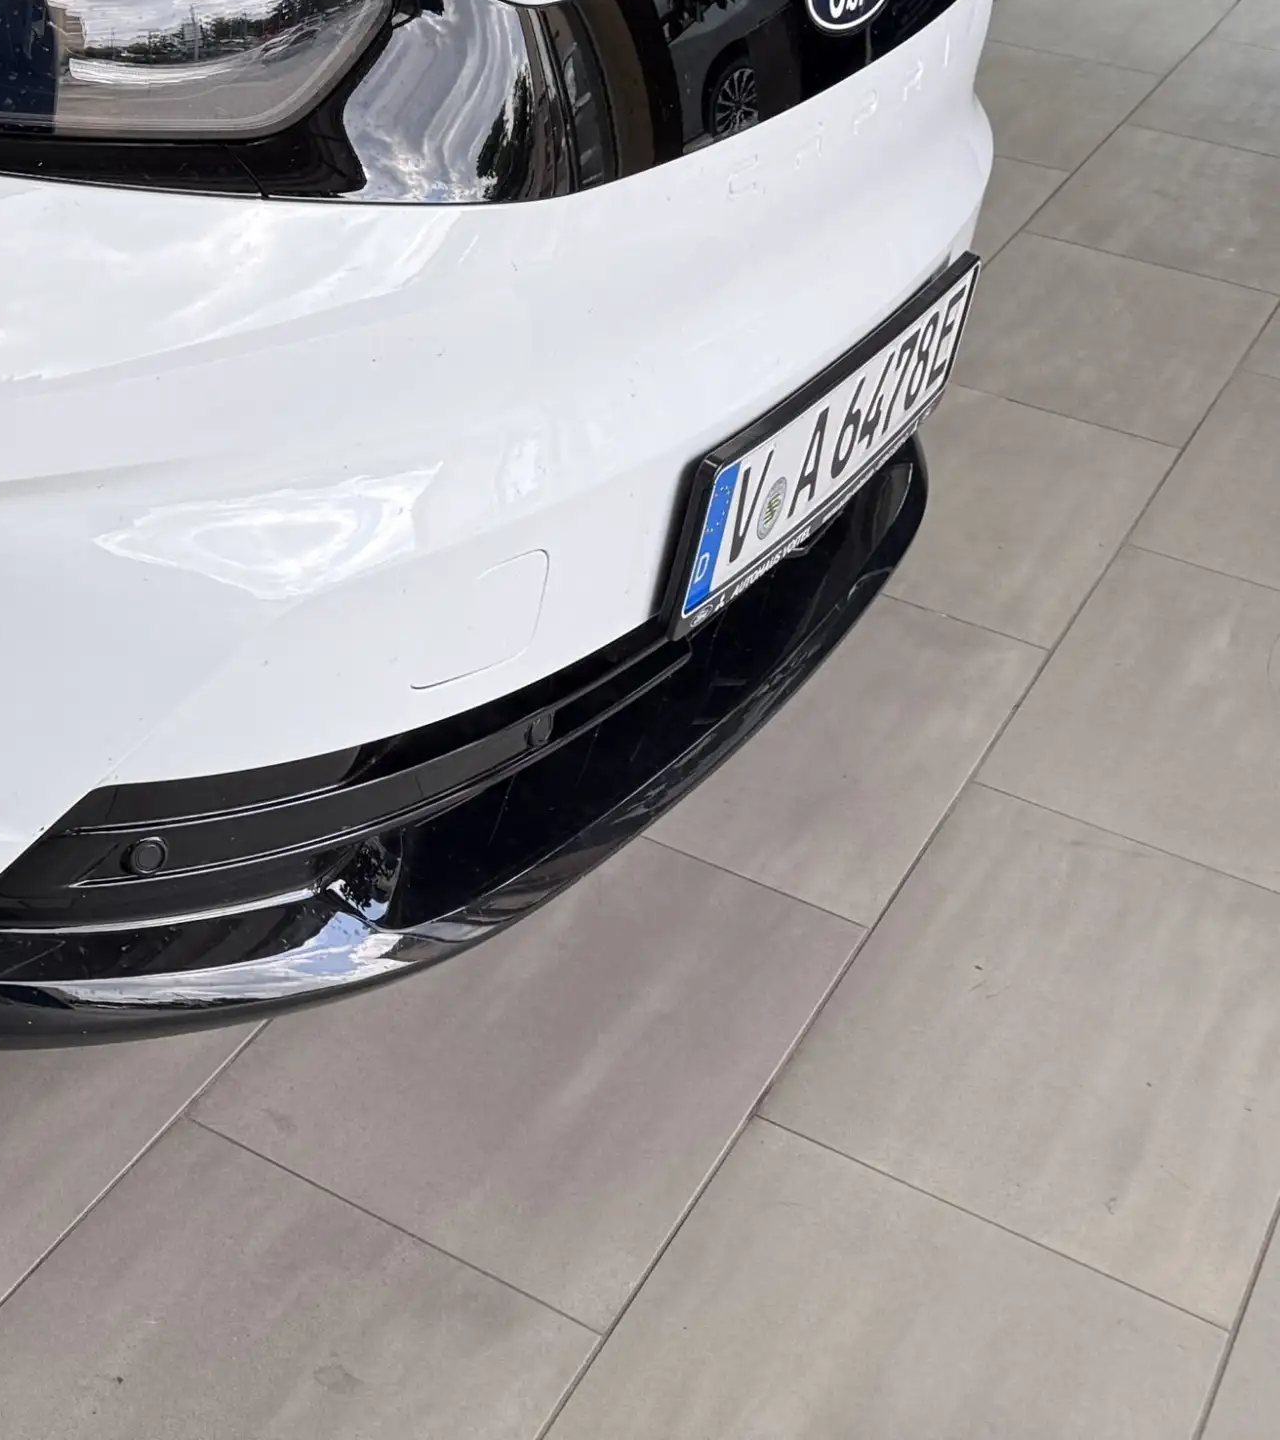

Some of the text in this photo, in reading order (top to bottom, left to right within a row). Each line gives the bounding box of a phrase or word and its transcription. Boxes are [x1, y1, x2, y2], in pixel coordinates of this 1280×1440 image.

[728, 449, 775, 563] V
[787, 405, 830, 519] A
[831, 283, 967, 480] 6478E
[693, 553, 710, 583] D
